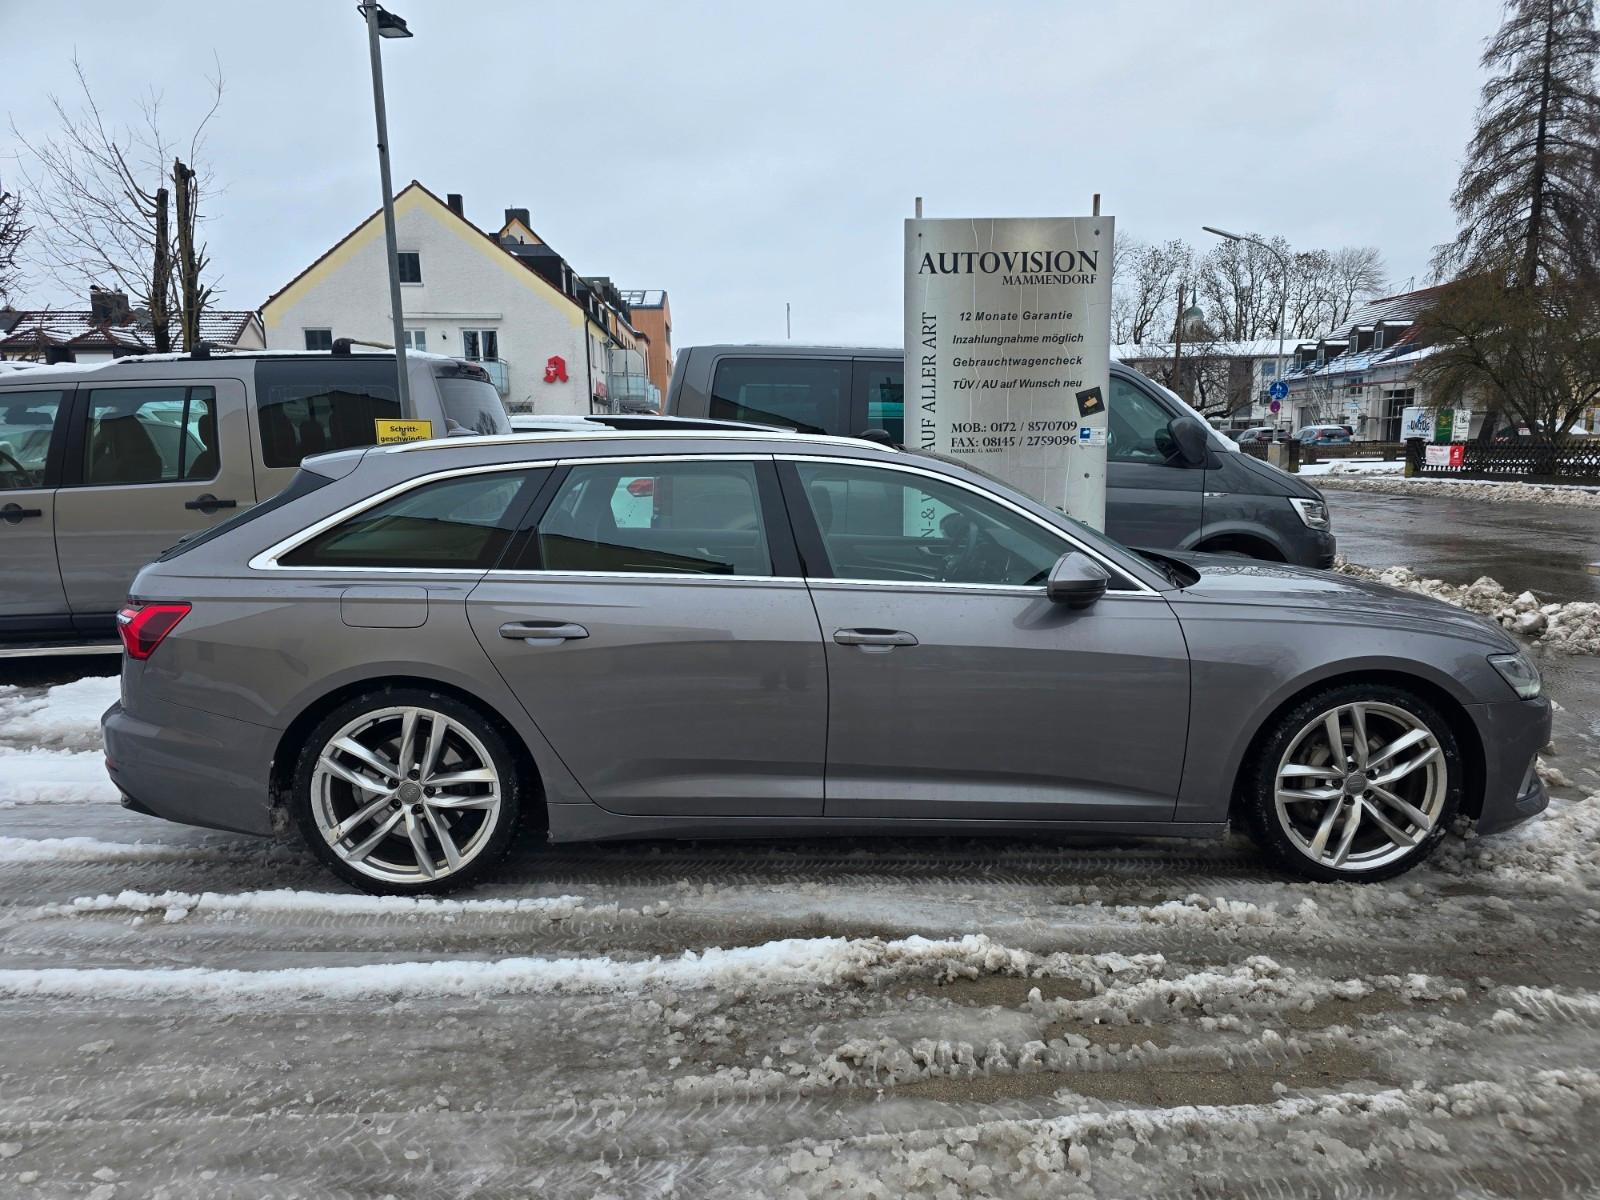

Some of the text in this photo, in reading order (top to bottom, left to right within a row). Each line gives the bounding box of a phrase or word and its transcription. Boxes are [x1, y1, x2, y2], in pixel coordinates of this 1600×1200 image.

[918, 250, 1099, 275] AUTOVISION
[1002, 274, 1097, 286] MAMMENDORF
[959, 310, 1073, 321] 12 Monate Garantie
[922, 312, 937, 350] ART
[952, 334, 1084, 346] Inzahlungnahme möglich
[952, 356, 1083, 368] Gebrauchtwagencheck
[922, 353, 937, 413] ALLER
[953, 379, 975, 389] TÜV
[982, 379, 998, 389] AU
[1000, 378, 1017, 389] auf
[1019, 378, 1060, 388] Wunsch
[1062, 379, 1082, 388] neu
[990, 422, 1016, 432] 0172
[1027, 421, 1078, 432] 8570709
[951, 437, 979, 448] FAX:
[982, 436, 1015, 447] 08145
[1026, 435, 1077, 446] 2759096
